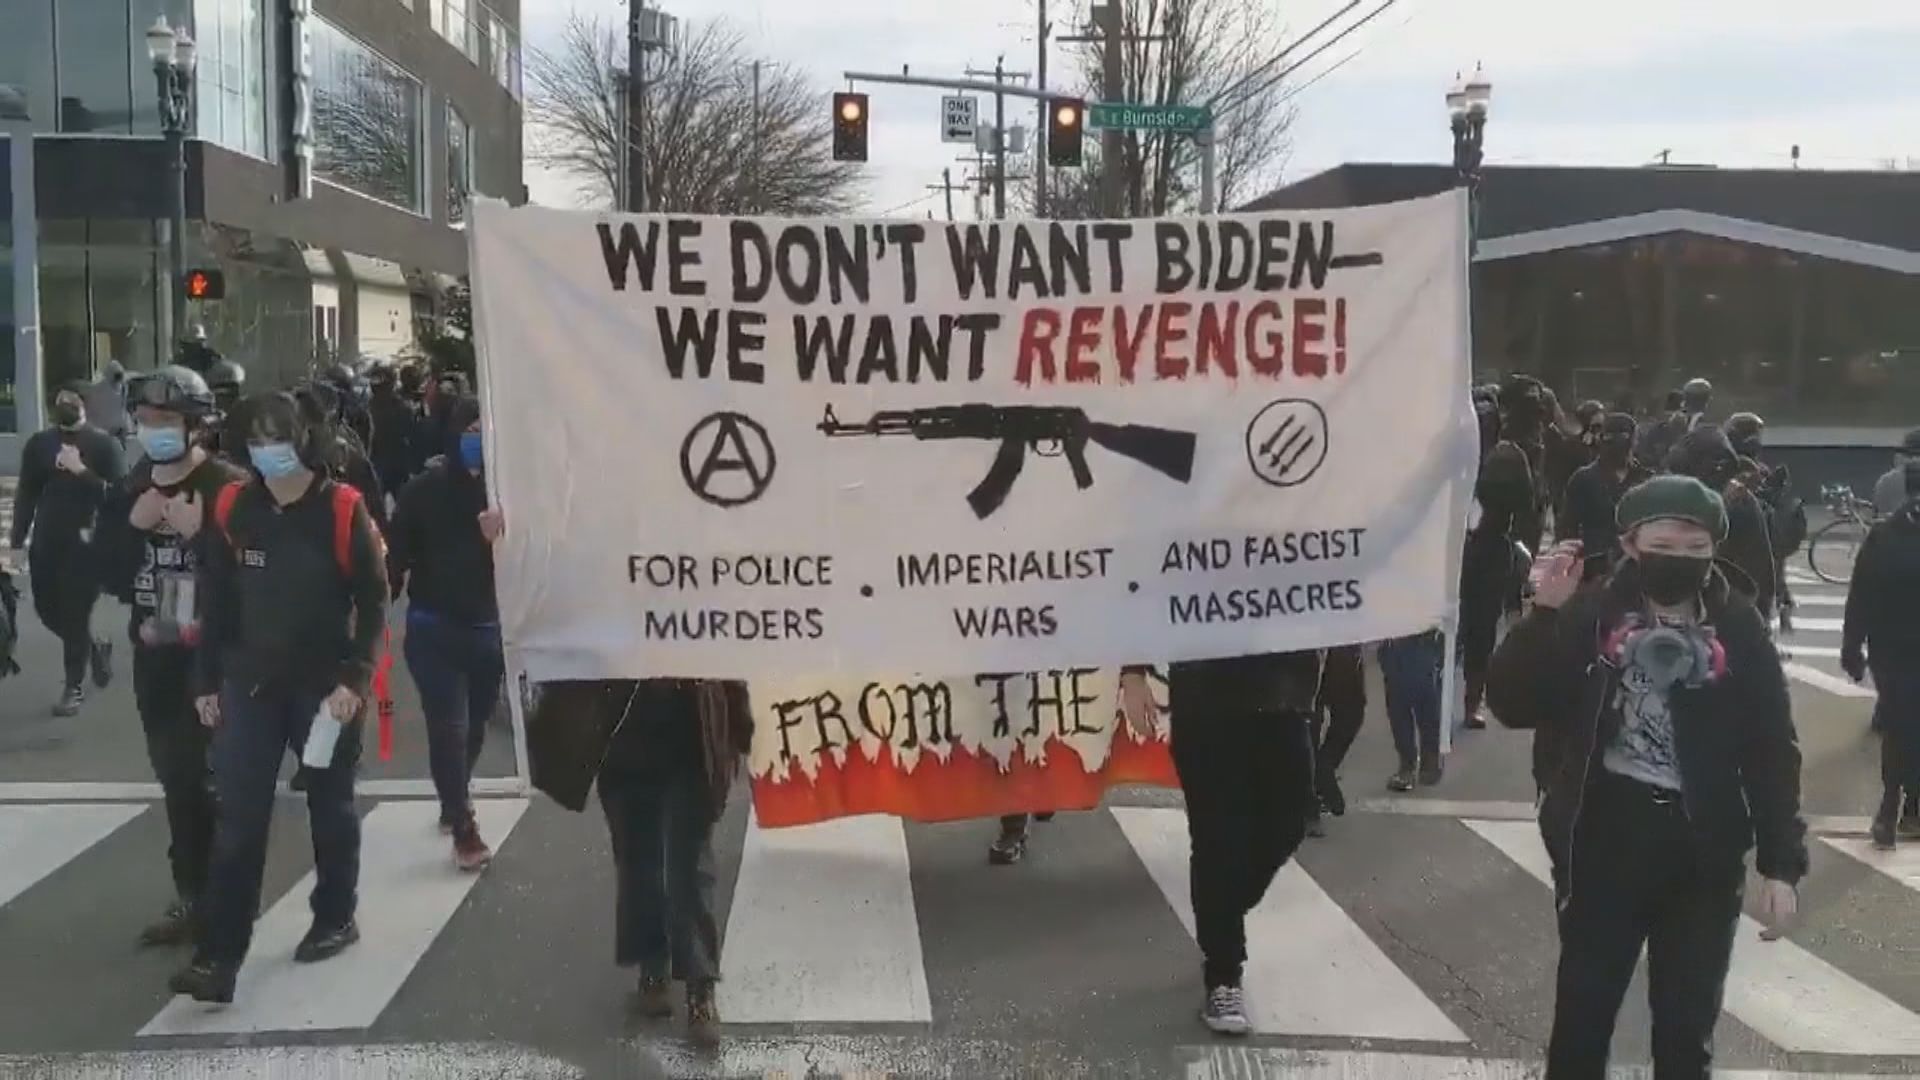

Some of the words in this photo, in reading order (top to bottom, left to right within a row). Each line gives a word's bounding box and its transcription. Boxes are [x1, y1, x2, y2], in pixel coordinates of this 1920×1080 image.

[947, 113, 971, 125] WAY
[948, 100, 970, 112] ONE
[596, 219, 706, 295] WE
[730, 220, 925, 305] DON'T
[945, 222, 1133, 299] WANT
[655, 307, 766, 383] WE
[793, 313, 1000, 384] WANT
[1013, 298, 1347, 387] REVENGE!
[897, 547, 1114, 589] IMPERIALIST
[1161, 539, 1231, 574] AND
[1244, 528, 1366, 568] FASCIST
[628, 555, 698, 590] FOR
[712, 555, 833, 586] POLICE
[953, 605, 1057, 638] WARS
[1169, 579, 1363, 625] MASSACRES
[645, 608, 824, 640] MURDERS
[771, 681, 953, 761] FROM
[975, 666, 1104, 738] THE
